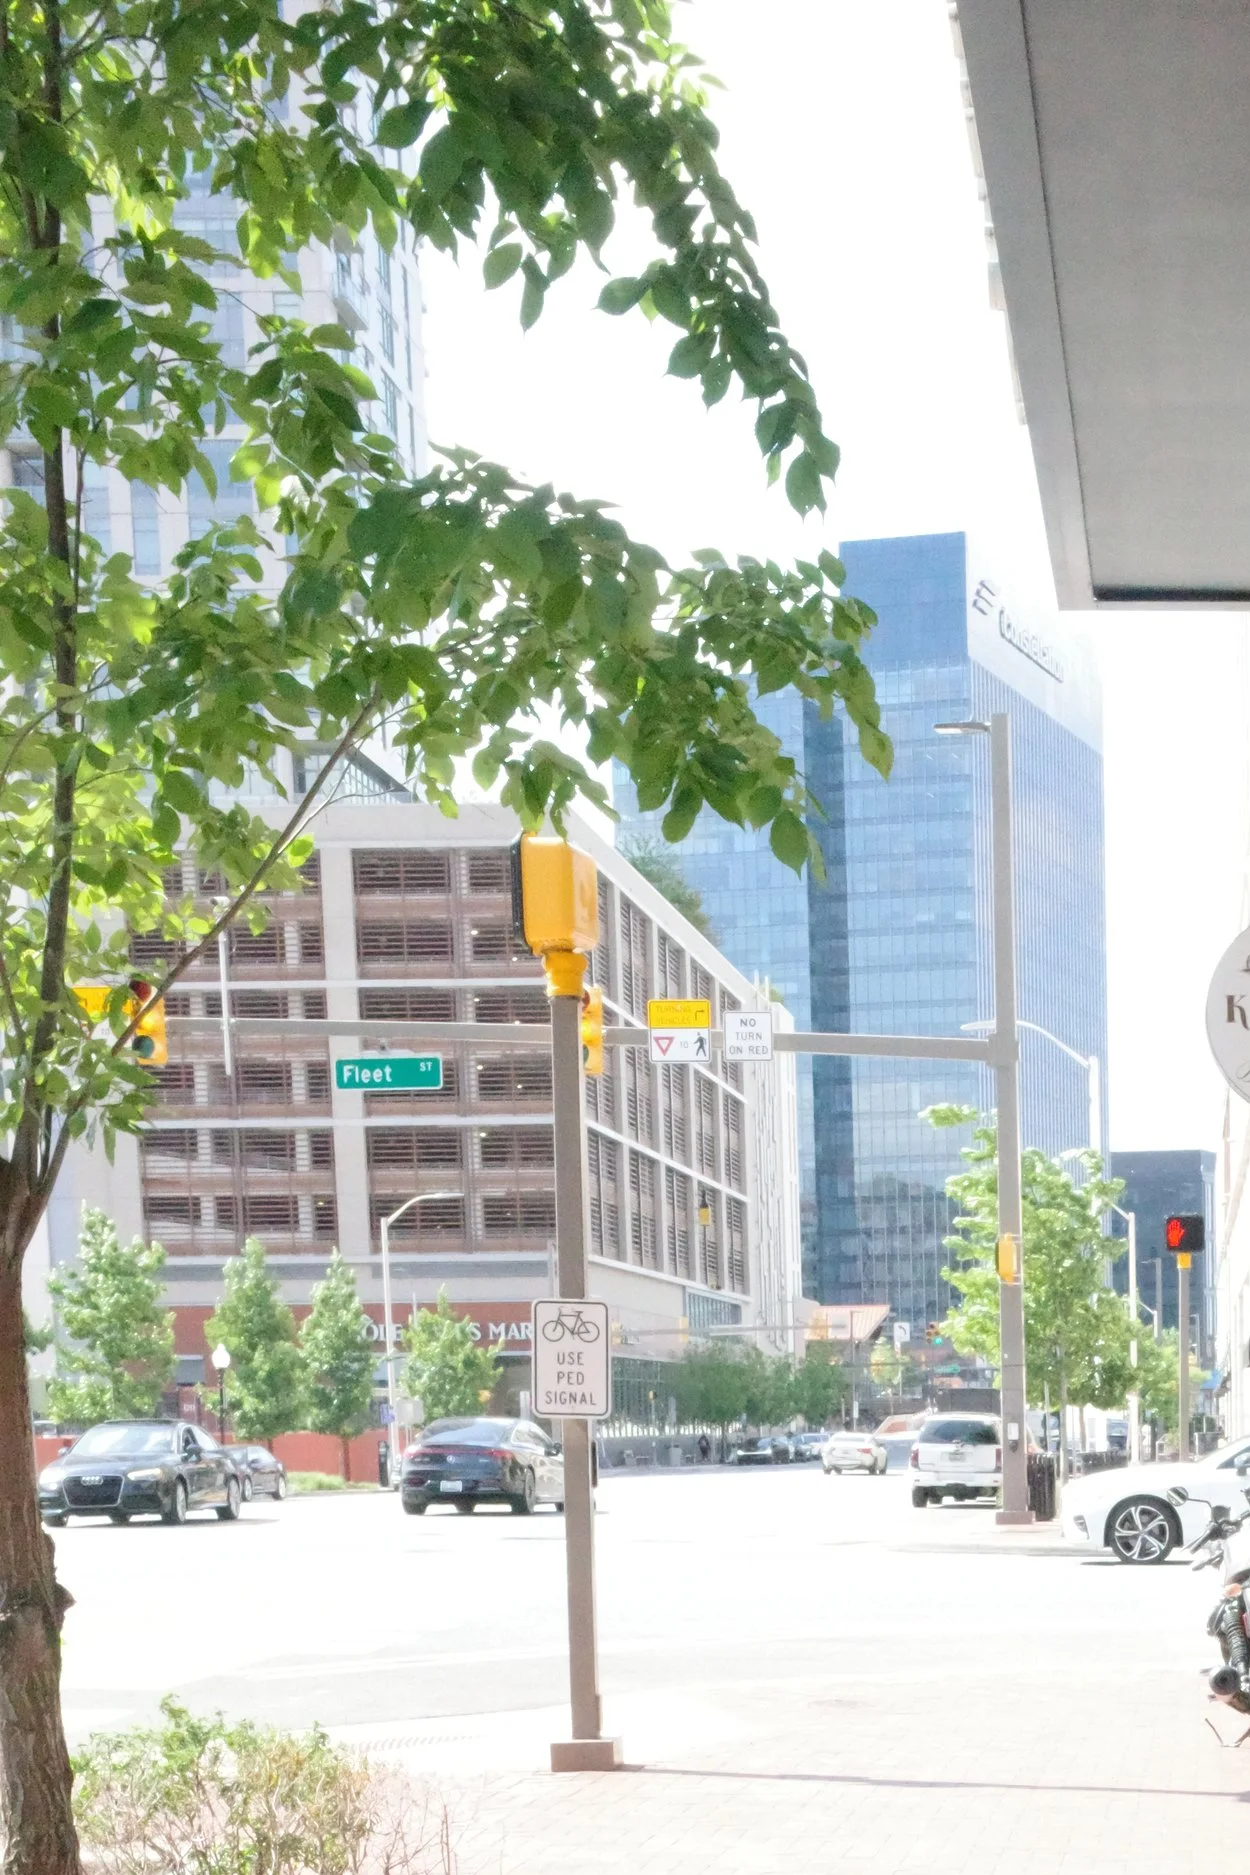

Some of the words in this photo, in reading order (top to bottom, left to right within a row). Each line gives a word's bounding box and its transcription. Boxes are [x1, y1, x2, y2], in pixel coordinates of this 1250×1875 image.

[740, 1018, 756, 1027] NO
[735, 1032, 762, 1040] TURN
[729, 1046, 743, 1054] ON
[748, 1045, 768, 1054] RED
[343, 1064, 392, 1083] Fleet
[419, 1061, 432, 1071] ST
[557, 1352, 584, 1366] USE
[557, 1371, 584, 1385] PED
[545, 1390, 596, 1406] SIGNAL
